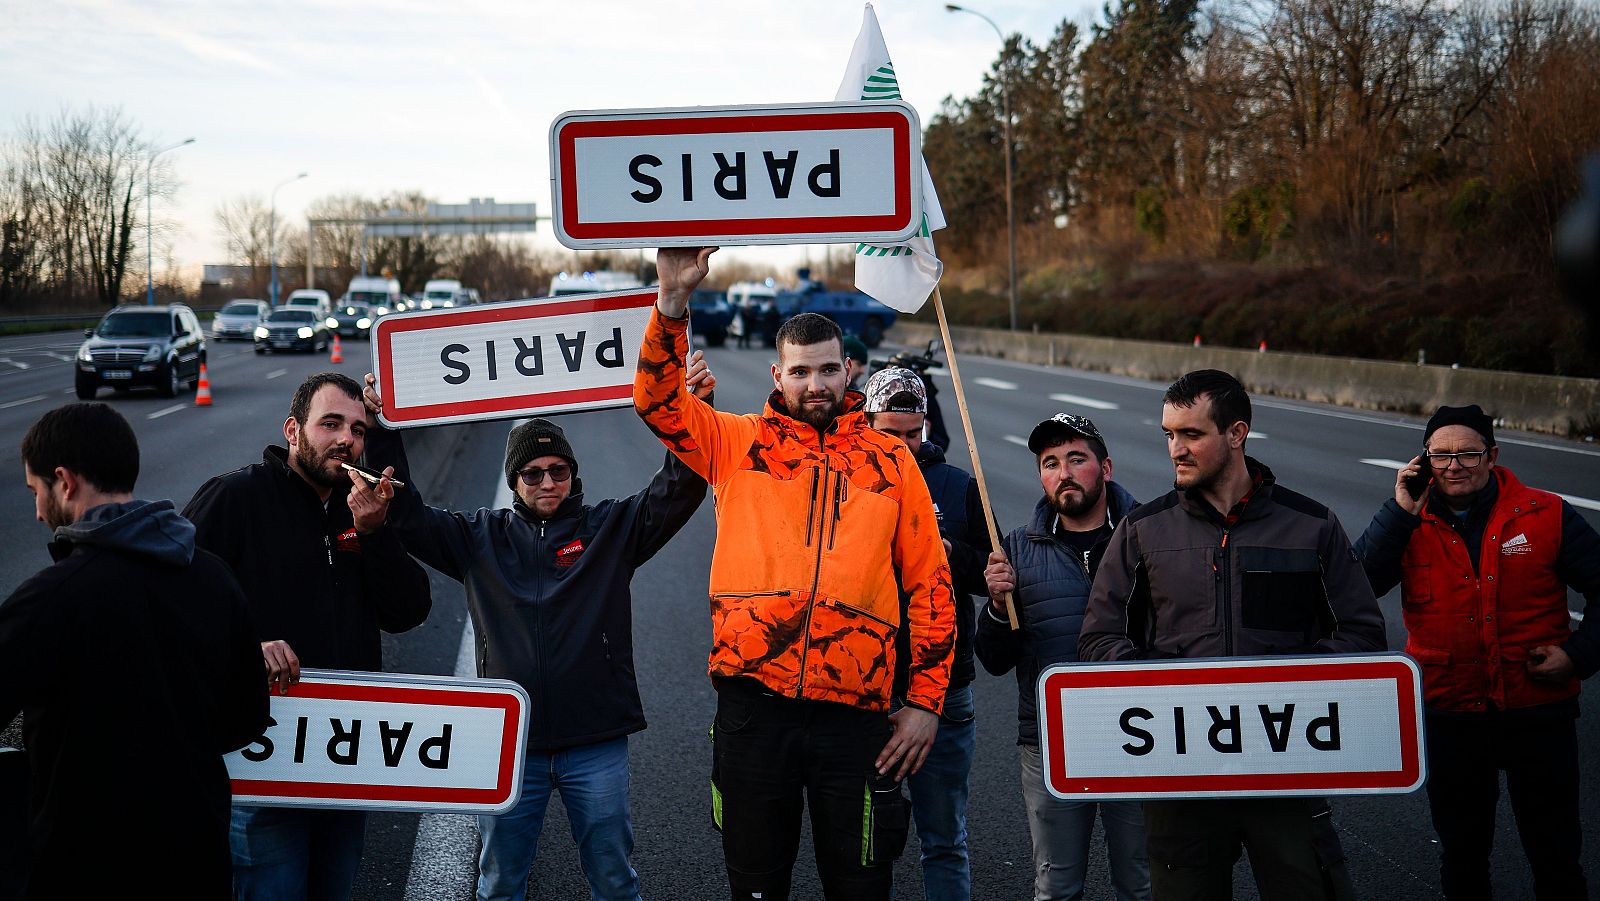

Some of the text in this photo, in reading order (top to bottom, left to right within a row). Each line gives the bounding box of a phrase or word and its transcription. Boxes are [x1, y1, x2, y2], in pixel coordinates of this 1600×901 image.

[629, 149, 841, 204] PARIS
[441, 327, 625, 385] PARIS
[1119, 702, 1342, 757] PARIS
